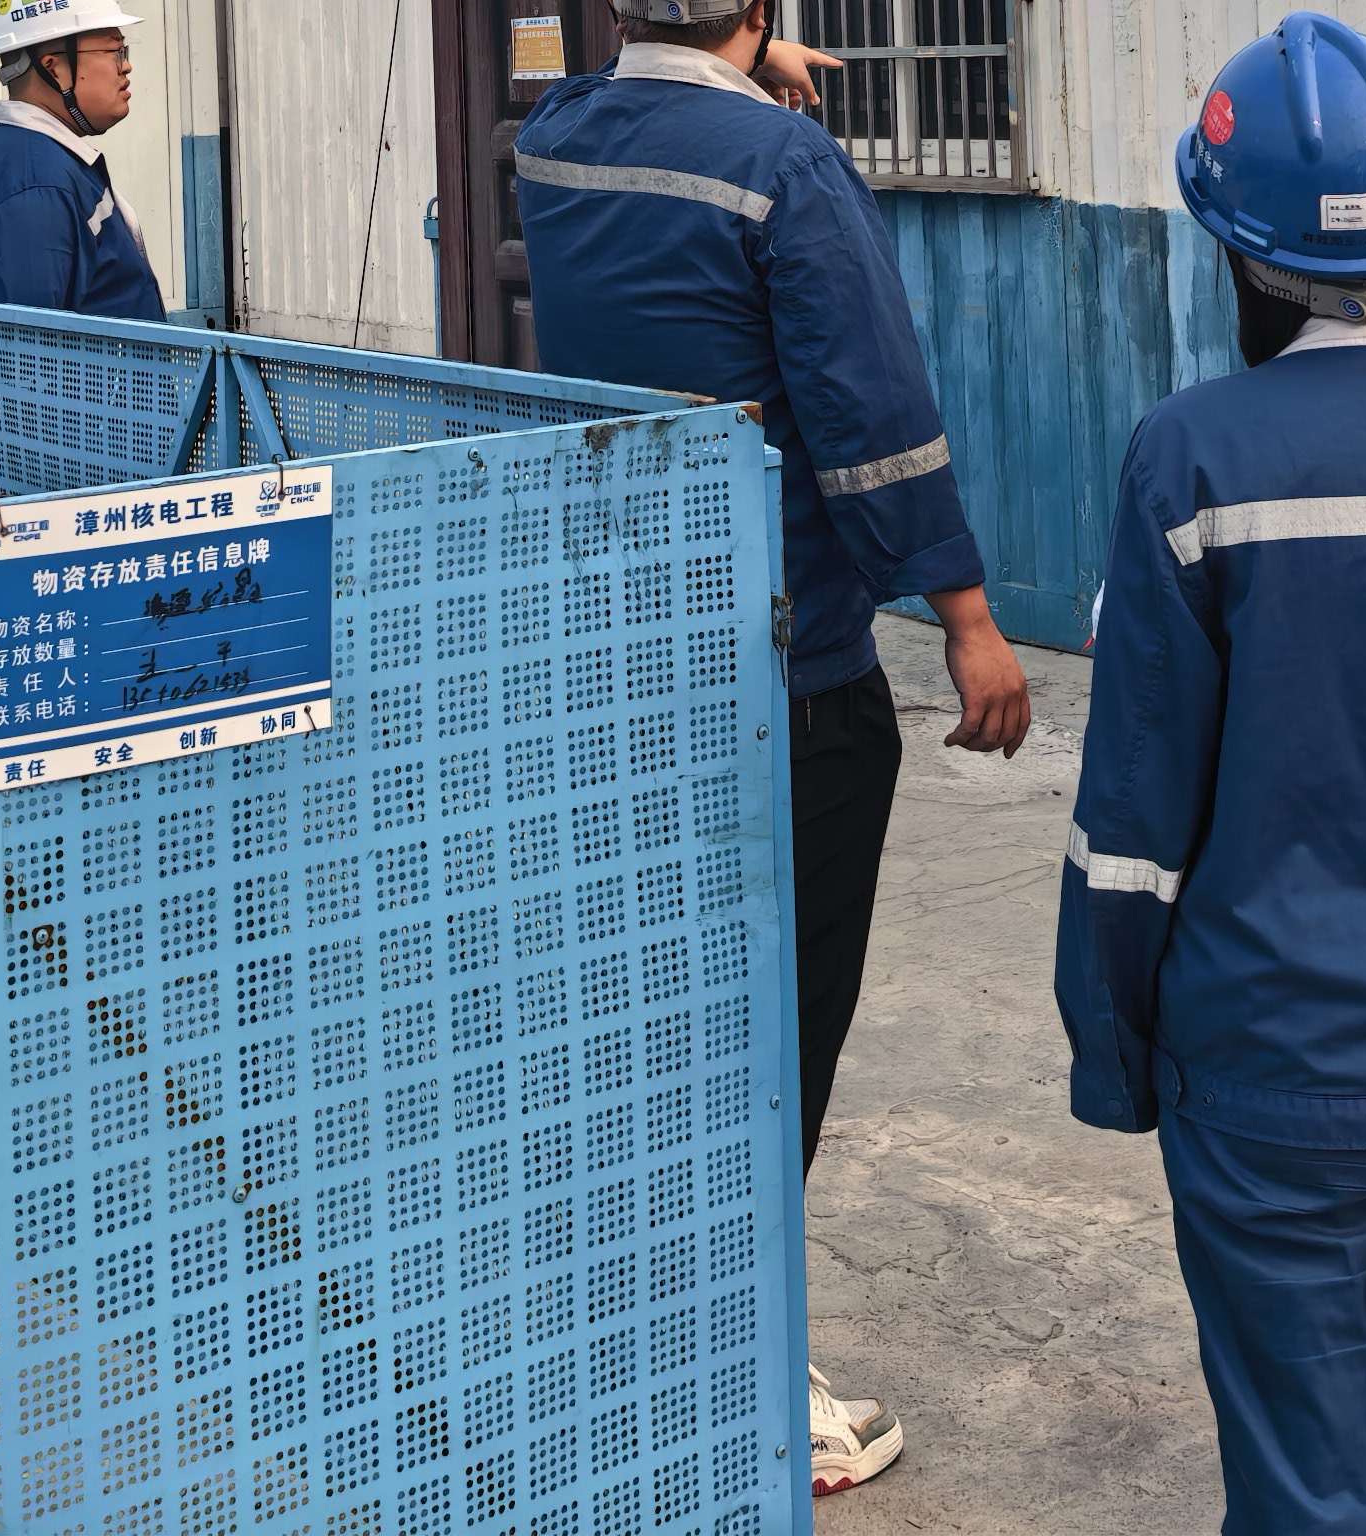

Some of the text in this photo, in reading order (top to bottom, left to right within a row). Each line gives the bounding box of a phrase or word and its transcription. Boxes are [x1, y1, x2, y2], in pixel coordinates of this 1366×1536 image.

[75, 491, 234, 537] 漳州核电工程
[33, 537, 271, 598] 物资存放责任信息牌
[4, 711, 296, 783] 责任 安全 创新 协同
